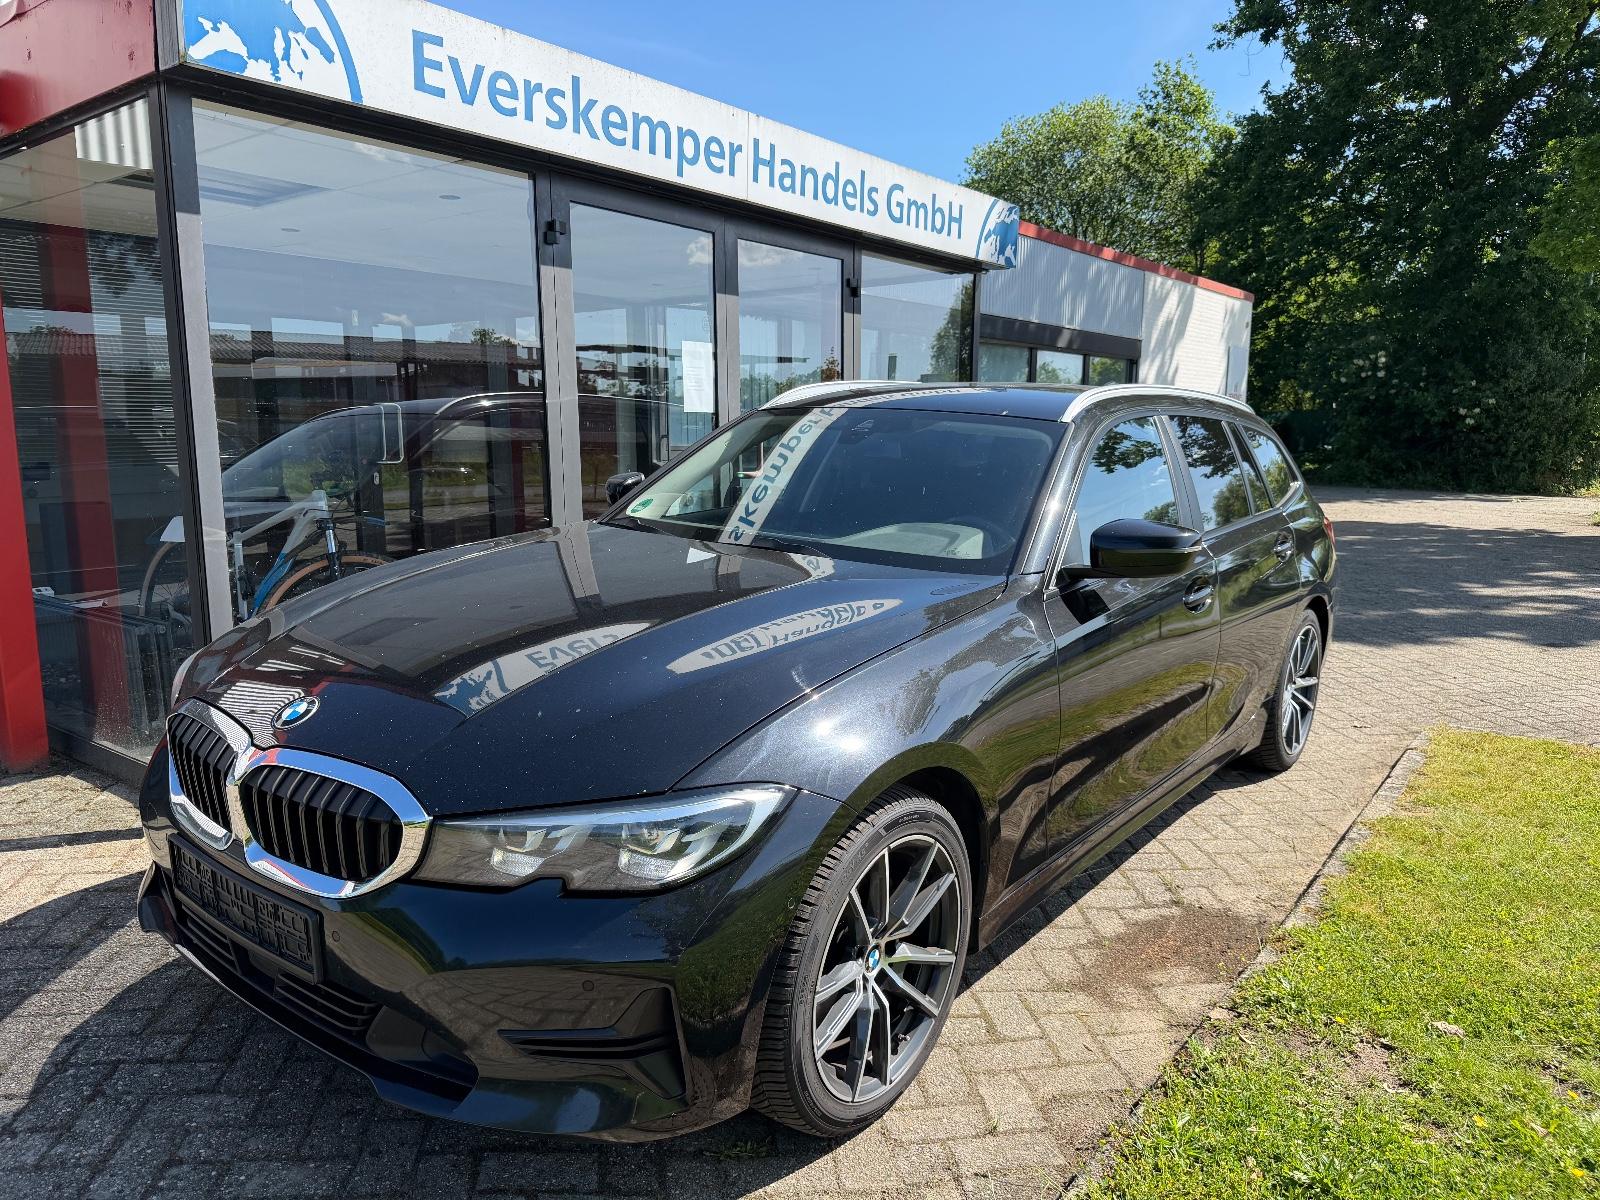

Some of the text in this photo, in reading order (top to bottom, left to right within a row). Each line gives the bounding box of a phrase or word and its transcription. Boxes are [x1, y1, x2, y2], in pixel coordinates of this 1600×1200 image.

[412, 29, 963, 240] Everskemper Handels GmbH
